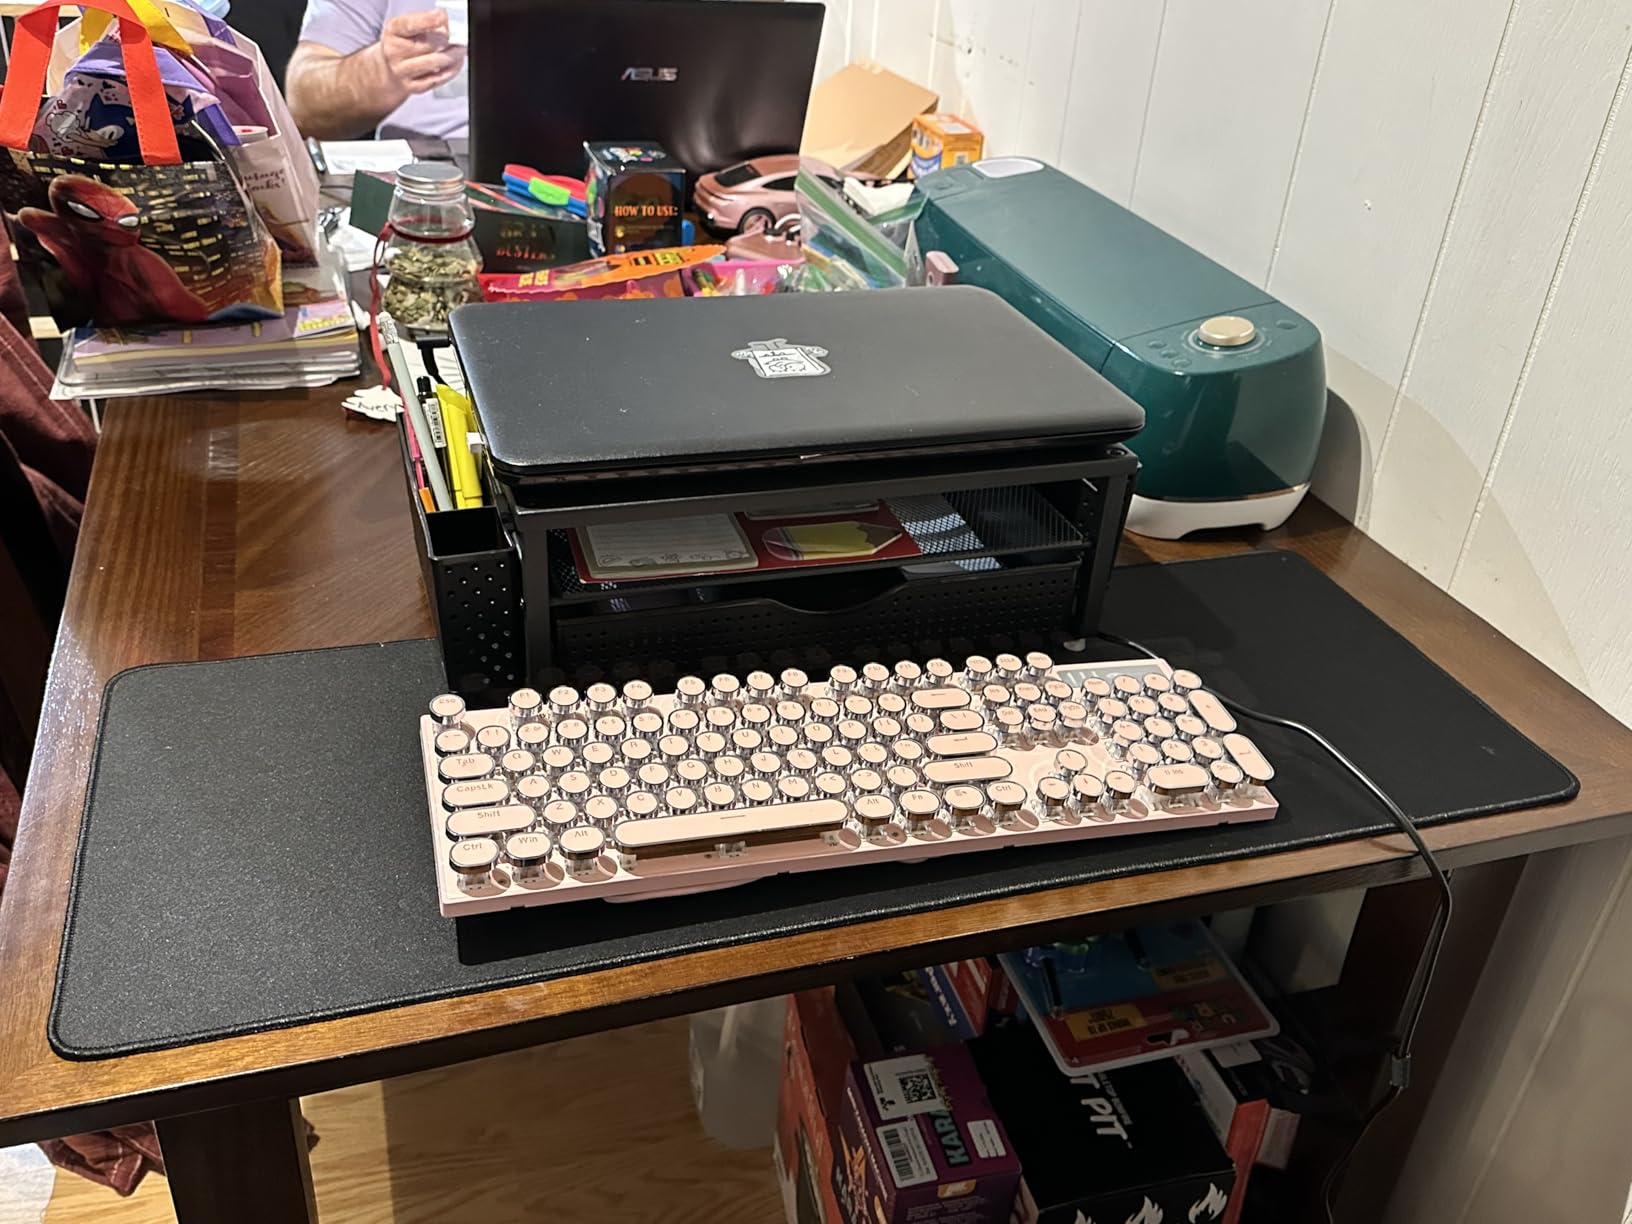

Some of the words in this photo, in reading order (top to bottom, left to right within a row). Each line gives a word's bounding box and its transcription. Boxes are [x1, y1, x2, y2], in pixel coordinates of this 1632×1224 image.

[621, 67, 677, 82] ASUS
[614, 204, 639, 217] HOW
[640, 204, 656, 217] TO
[656, 204, 679, 217] USE:
[456, 757, 476, 768] Tab
[953, 761, 974, 769] Shift
[456, 783, 494, 793] CapsLk
[995, 785, 1012, 793] Ctrl
[866, 798, 880, 806] Alt
[477, 810, 501, 819] Shift
[574, 830, 589, 838] Alt
[518, 836, 538, 845] Win
[462, 843, 482, 852] Ctrl
[1080, 1096, 1130, 1141] PIT
